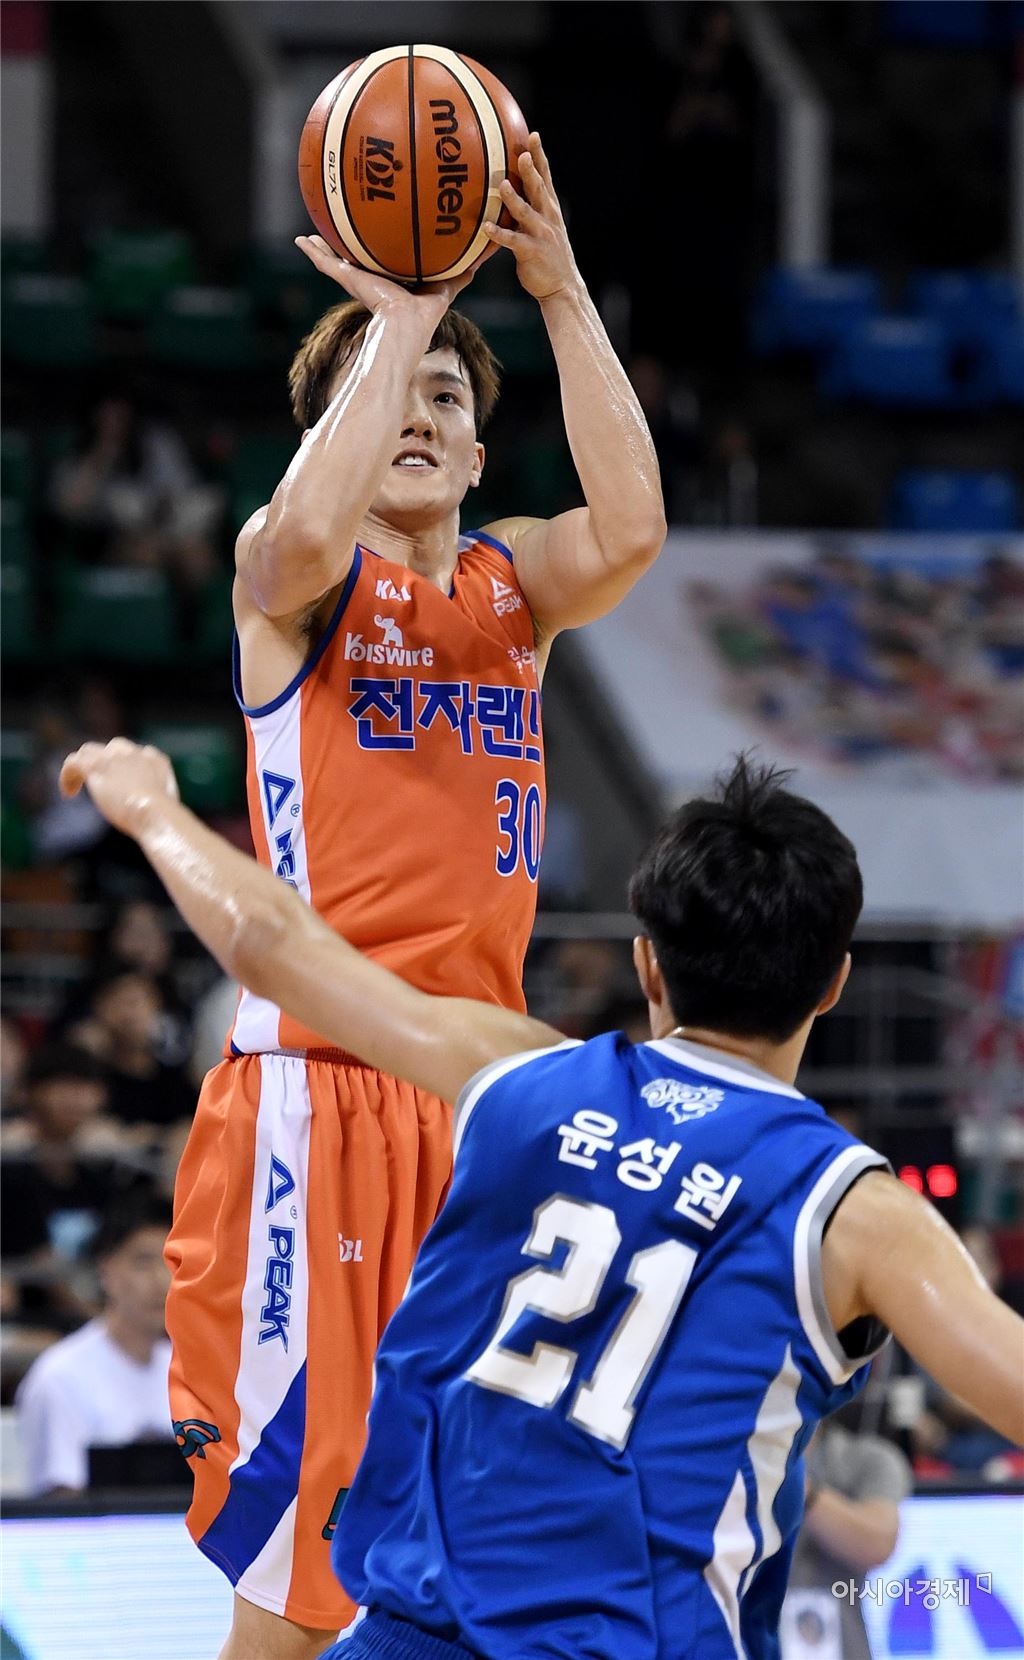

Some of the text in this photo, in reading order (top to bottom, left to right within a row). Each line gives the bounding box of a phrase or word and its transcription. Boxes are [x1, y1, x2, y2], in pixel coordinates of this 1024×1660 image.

[328, 151, 338, 195] GL7X
[365, 135, 396, 202] KBL
[429, 99, 468, 236] molten
[495, 778, 541, 883] 30
[557, 1109, 742, 1232] 윤성원
[258, 1224, 295, 1354] PEAK
[338, 1232, 363, 1263] BL
[463, 1192, 698, 1450] 21
